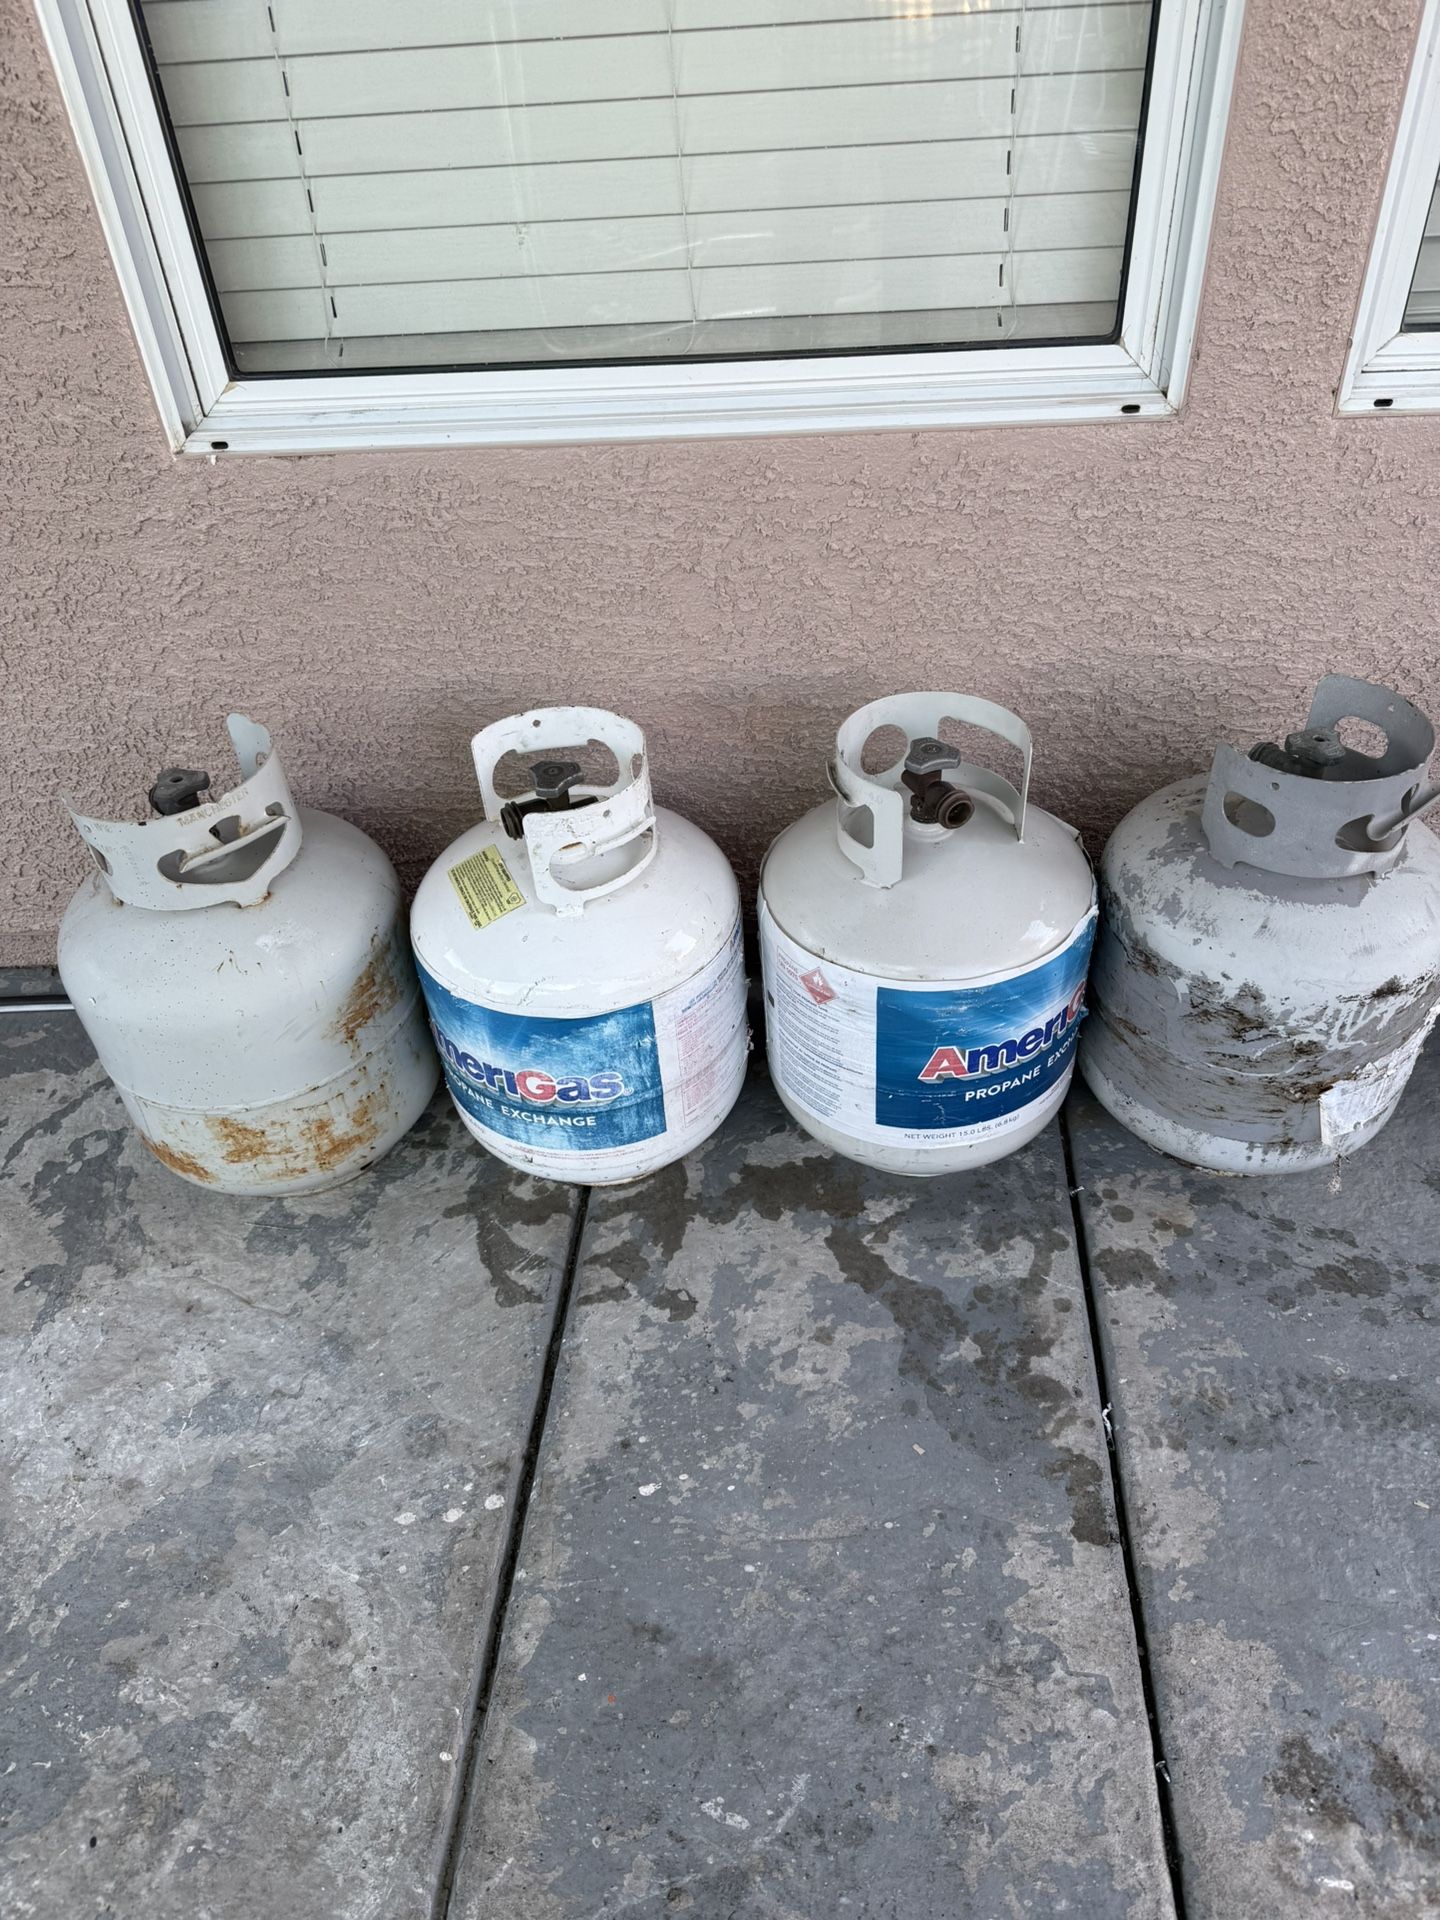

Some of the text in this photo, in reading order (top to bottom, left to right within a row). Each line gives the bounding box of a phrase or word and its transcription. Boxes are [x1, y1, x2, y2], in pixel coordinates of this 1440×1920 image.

[430, 1022, 624, 1106] meriGas
[965, 1065, 1041, 1102] PROPANE
[446, 1066, 494, 1109] OPANE
[500, 1105, 597, 1127] EXCHANGE
[922, 1131, 957, 1140] WEIGHT
[959, 1129, 976, 1137] 15.0
